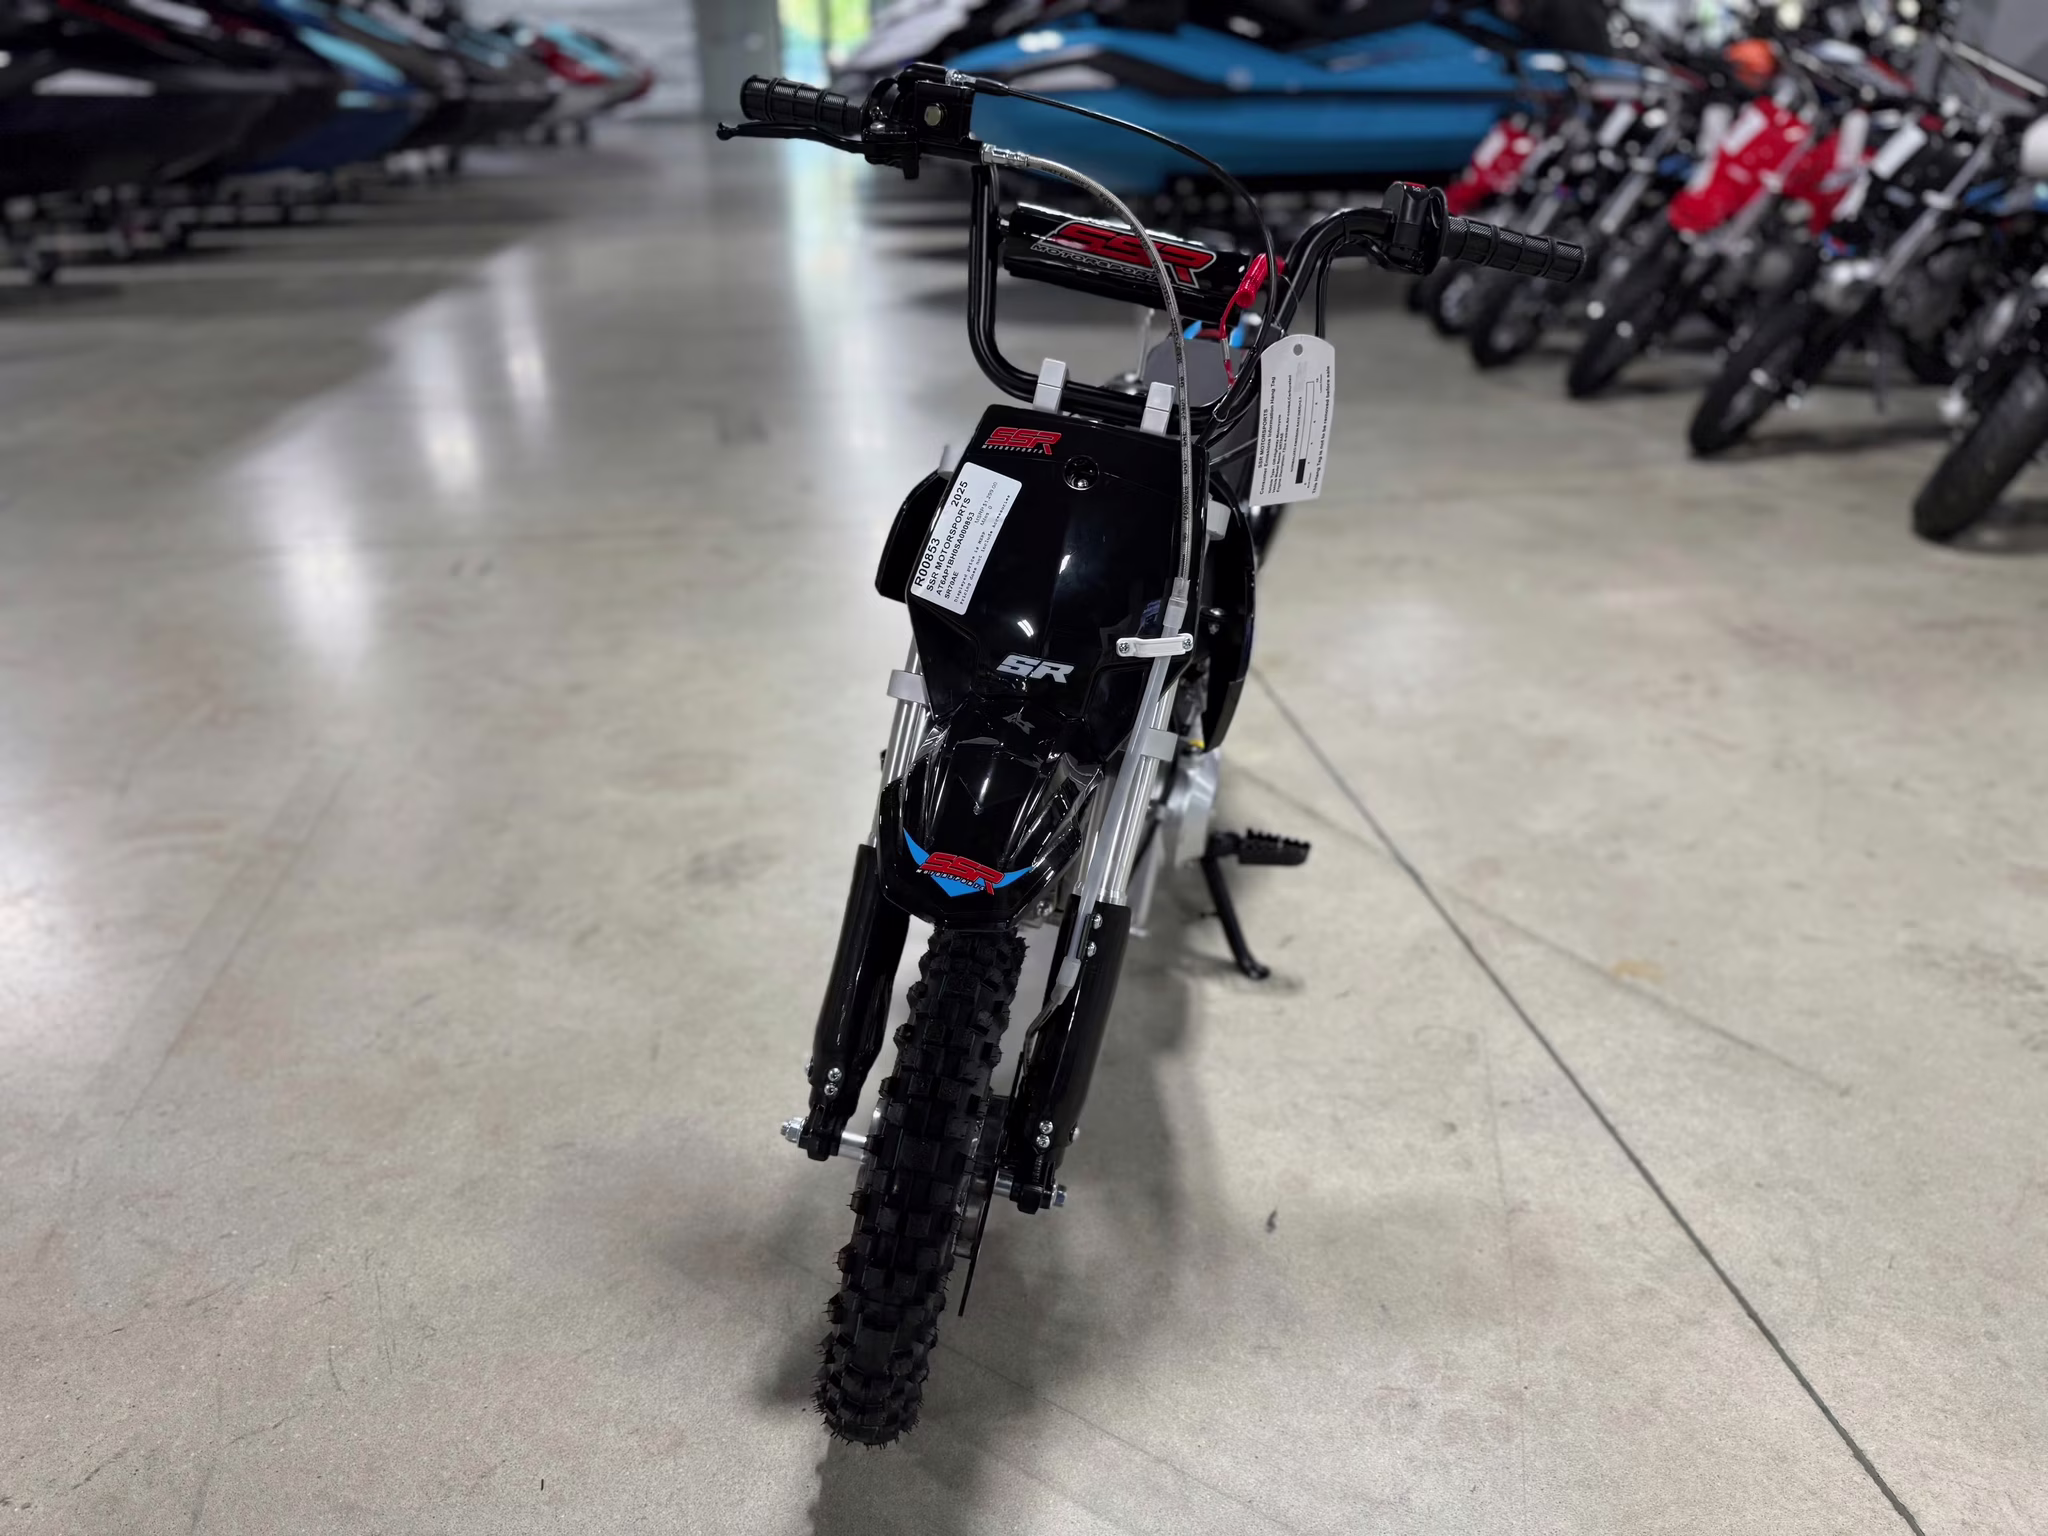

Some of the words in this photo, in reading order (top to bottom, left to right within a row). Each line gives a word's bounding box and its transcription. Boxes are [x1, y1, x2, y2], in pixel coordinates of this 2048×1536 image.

[1049, 222, 1217, 286] SSR
[981, 444, 1043, 454] MOTORSPORTS
[985, 426, 1062, 455] SSR
[1259, 408, 1268, 455] MOTORSPORTS
[1259, 467, 1267, 495] Consumer
[1263, 438, 1271, 467] Emissions
[914, 537, 941, 588] R00853
[950, 480, 969, 508] 2025
[926, 571, 939, 592] SSR
[934, 497, 970, 570] MOTORSPORTS
[944, 571, 959, 599] SR70AE
[996, 654, 1075, 684] SR
[915, 868, 985, 892] MOTORSPORTS
[919, 852, 1005, 896] SSR
